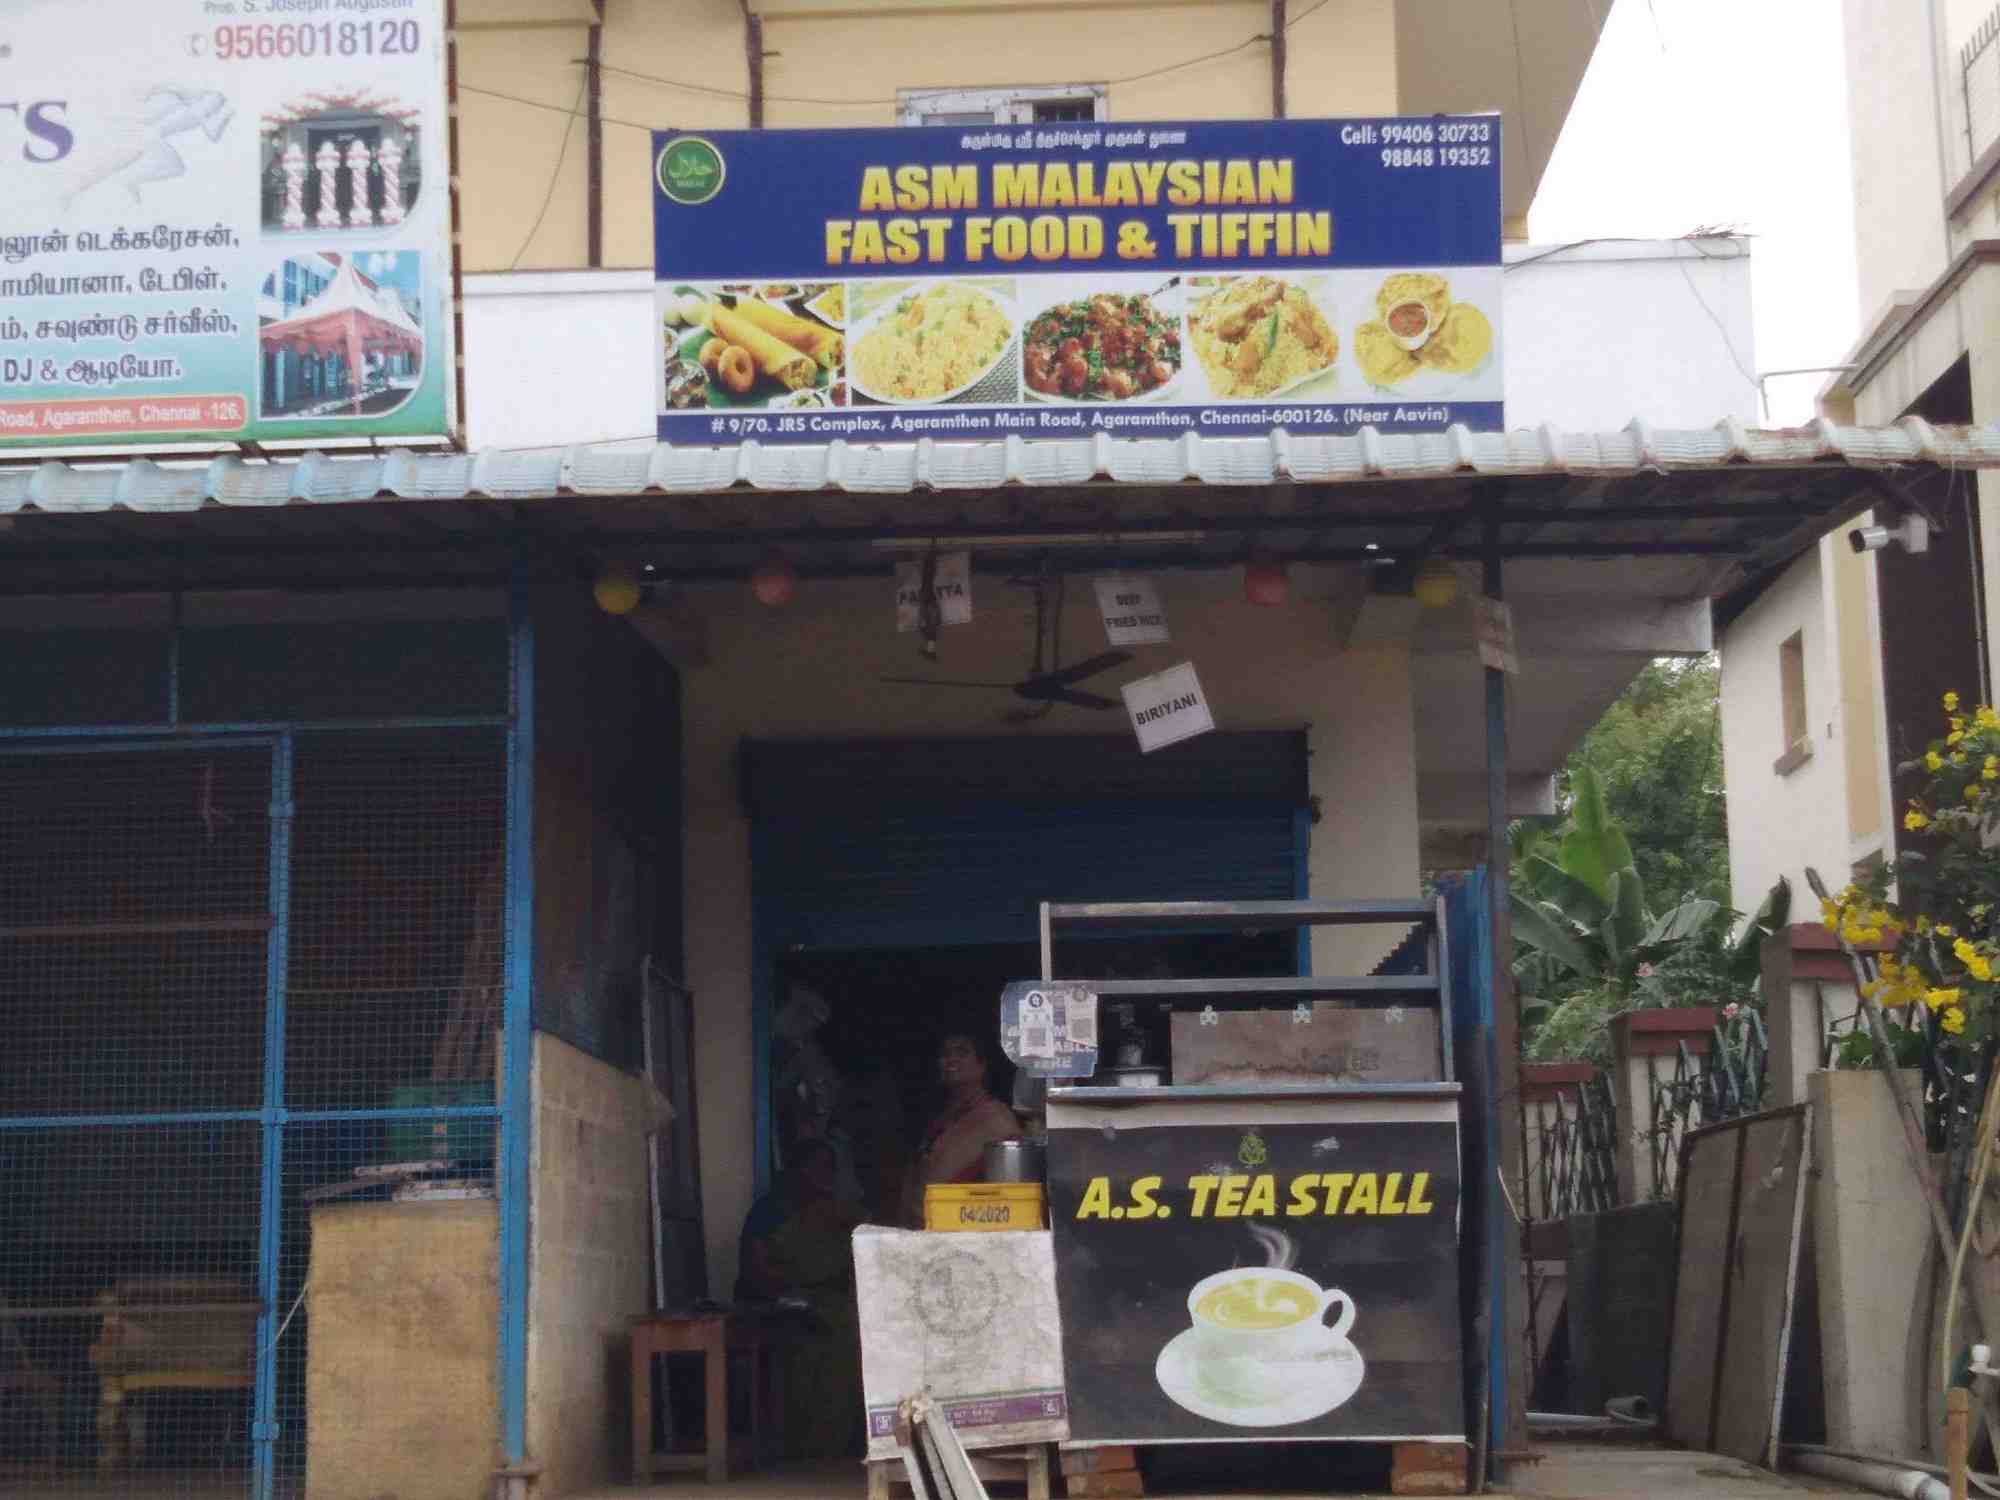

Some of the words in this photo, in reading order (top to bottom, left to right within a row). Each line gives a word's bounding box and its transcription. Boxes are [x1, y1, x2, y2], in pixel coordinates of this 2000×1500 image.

[215, 20, 419, 59] 9566018120
[1341, 125, 1377, 144] Cell:
[1381, 124, 1433, 144] 99406
[1438, 124, 1489, 143] 30733
[1381, 149, 1433, 167] 98848
[1439, 147, 1491, 166] 19352
[859, 165, 979, 211] ASM
[993, 160, 1296, 208] MALAYSIAN
[825, 218, 952, 265] FAST
[965, 214, 1104, 262] FOOD
[1116, 221, 1157, 260] &
[1168, 211, 1331, 258] TIFFIN
[139, 267, 227, 292] டேபிள்,
[36, 313, 138, 341] சவுண்டு
[4, 359, 32, 382] DJ
[41, 360, 58, 381] &
[66, 354, 181, 384] ஆடியோ.
[711, 417, 725, 433] #
[777, 417, 806, 432] JRS
[810, 414, 886, 435] Complex,
[891, 414, 989, 432] Agaramthen
[995, 411, 1034, 427] Main
[1040, 411, 1086, 428] Road,
[1092, 410, 1196, 429] Agaramthen,
[1201, 407, 1339, 426] Chennai-600126.
[1343, 406, 1390, 424] (Near
[1135, 692, 1198, 727] BIRIYANI
[1076, 1176, 1171, 1220] A.S.
[1188, 1173, 1276, 1218] TEA
[1285, 1171, 1435, 1216] STALL
